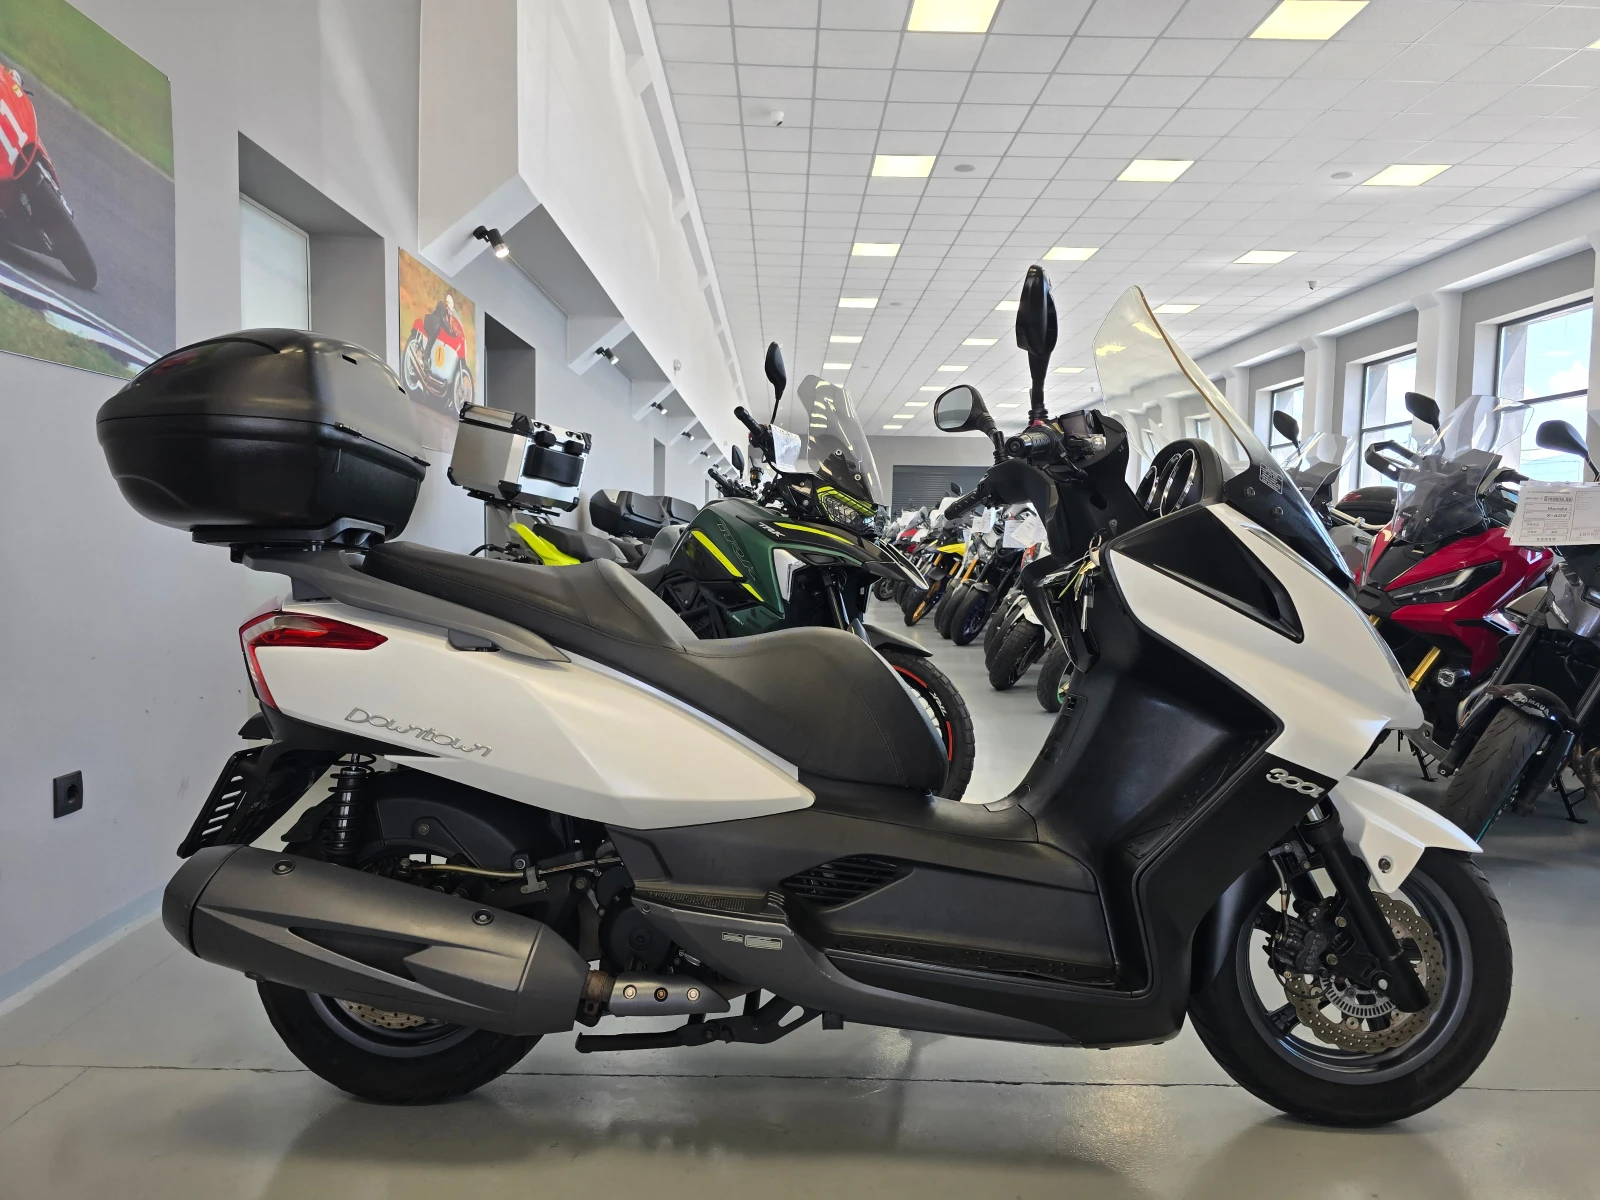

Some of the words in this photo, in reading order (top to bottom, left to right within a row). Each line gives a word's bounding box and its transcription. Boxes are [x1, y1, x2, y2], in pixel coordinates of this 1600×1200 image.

[758, 521, 786, 538] TRK
[344, 706, 493, 758] Downtown
[1265, 767, 1326, 799] 300i
